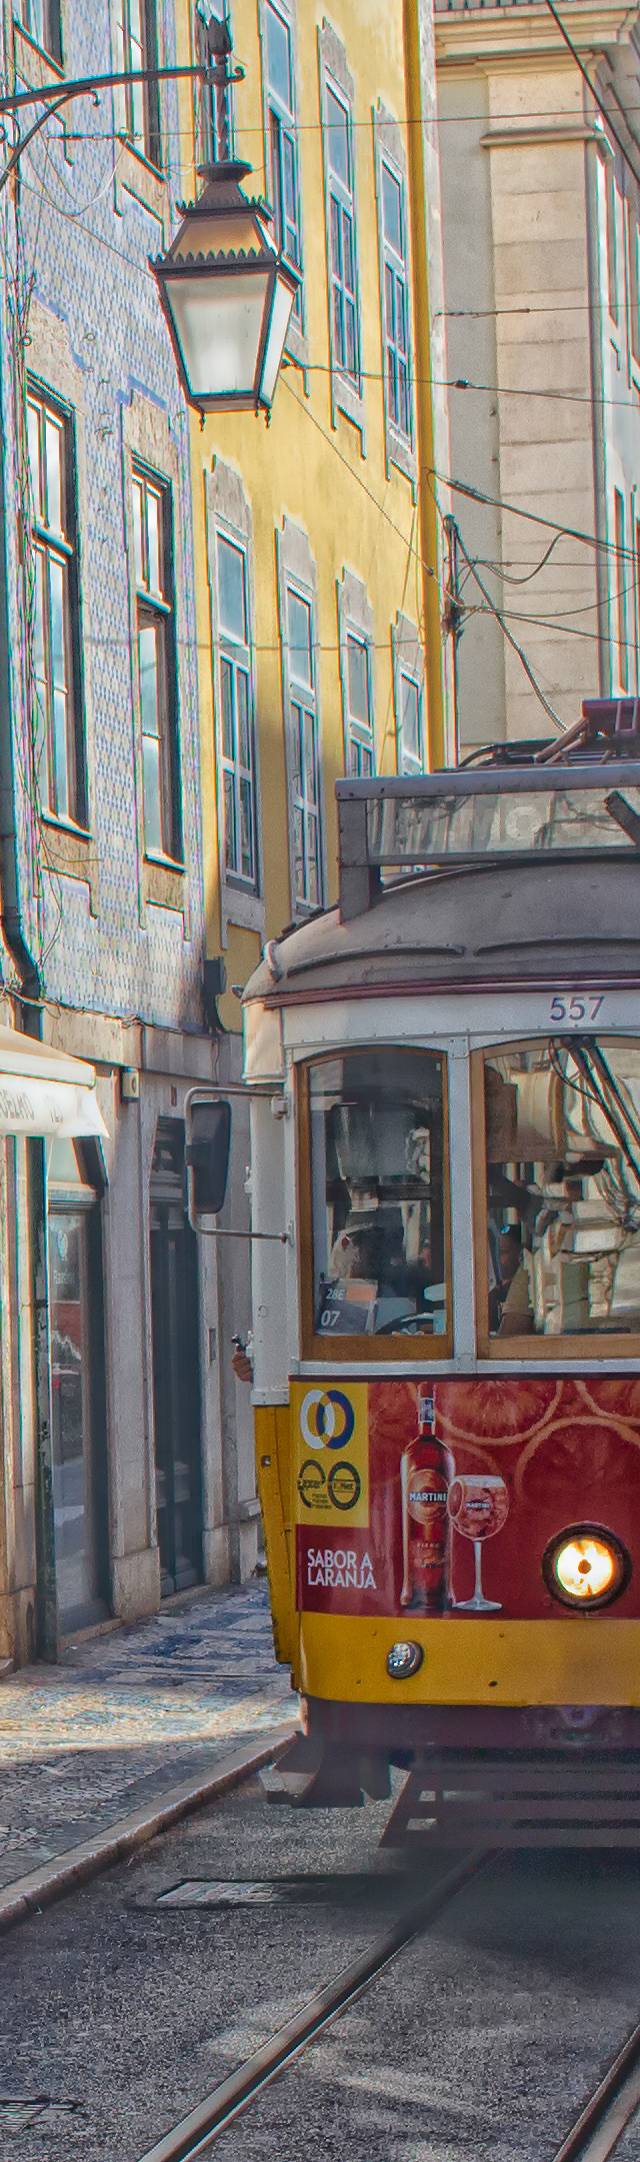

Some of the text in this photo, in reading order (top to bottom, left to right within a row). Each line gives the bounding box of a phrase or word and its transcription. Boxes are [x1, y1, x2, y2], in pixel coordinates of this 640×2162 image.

[550, 995, 604, 1021] 557
[326, 1289, 345, 1300] 28E
[321, 1310, 340, 1327] 07
[409, 1491, 448, 1502] MARTINI
[307, 1548, 374, 1570] SABOR A
[307, 1566, 377, 1589] LARANJA
